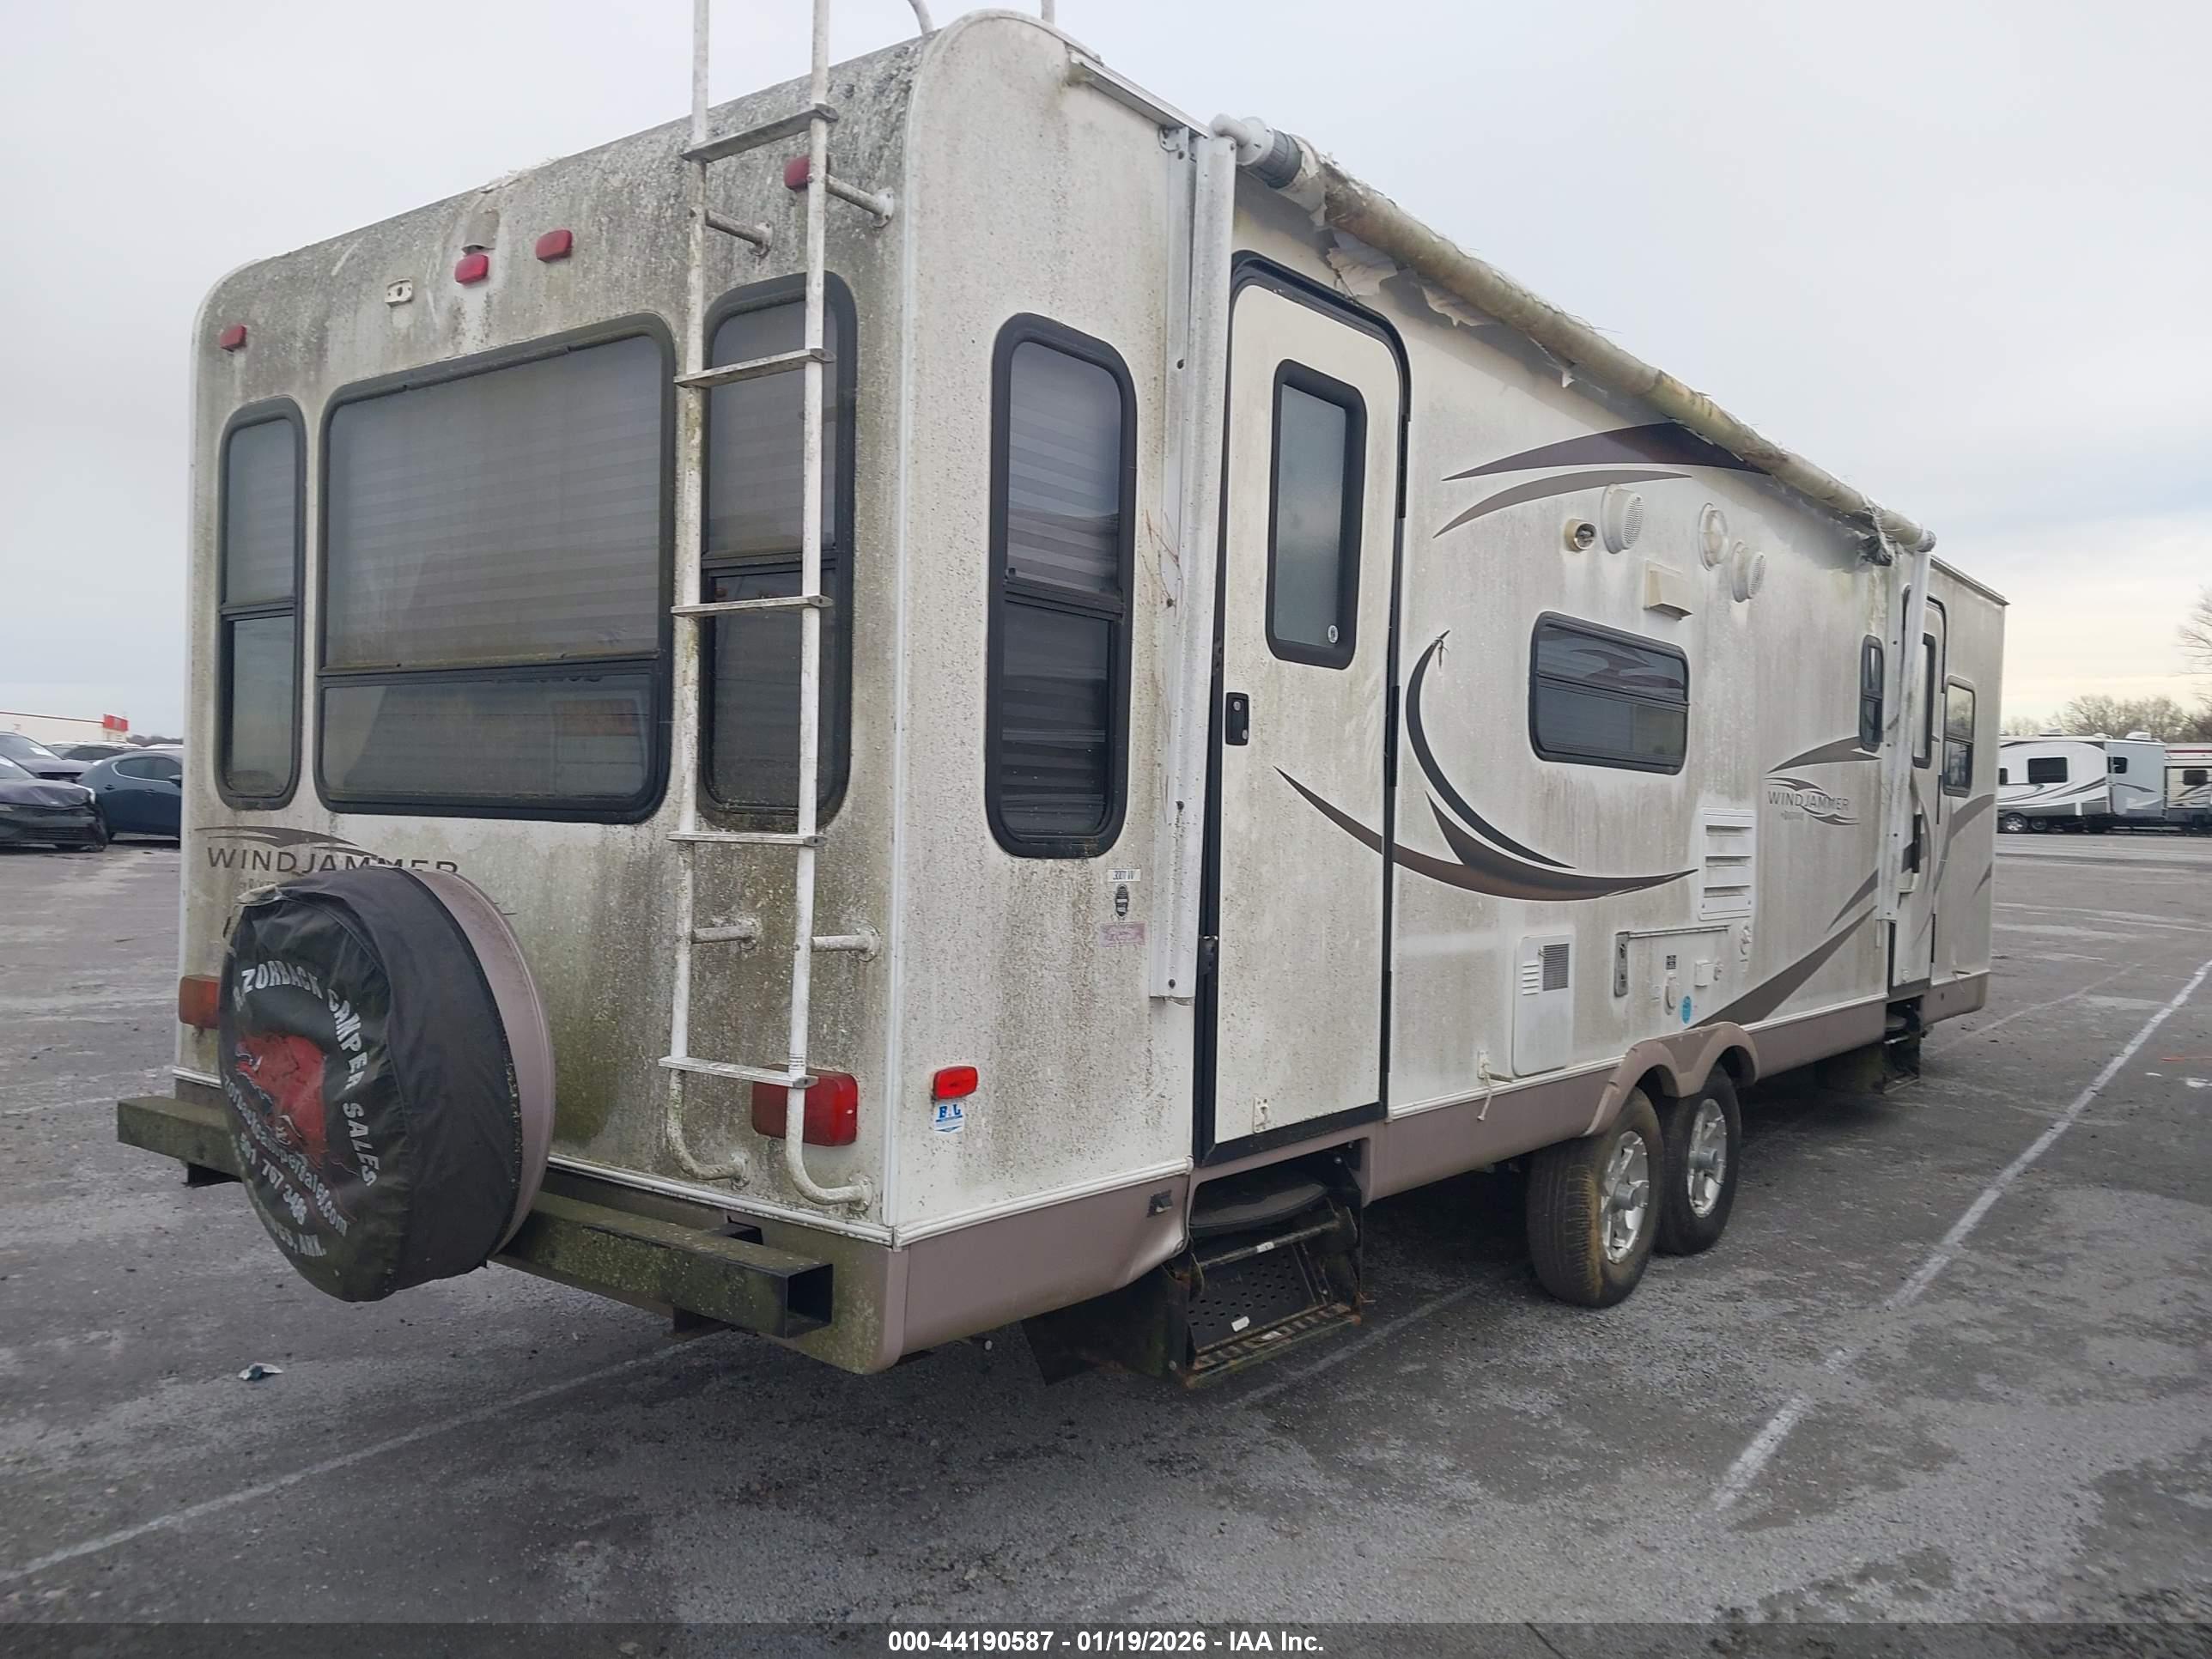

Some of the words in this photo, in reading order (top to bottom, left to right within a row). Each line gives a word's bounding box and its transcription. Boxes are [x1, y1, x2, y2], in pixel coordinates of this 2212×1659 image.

[1768, 790, 1849, 811] WINDJAMMER
[233, 960, 324, 1012] RZORBACK
[343, 1103, 380, 1187] SALES
